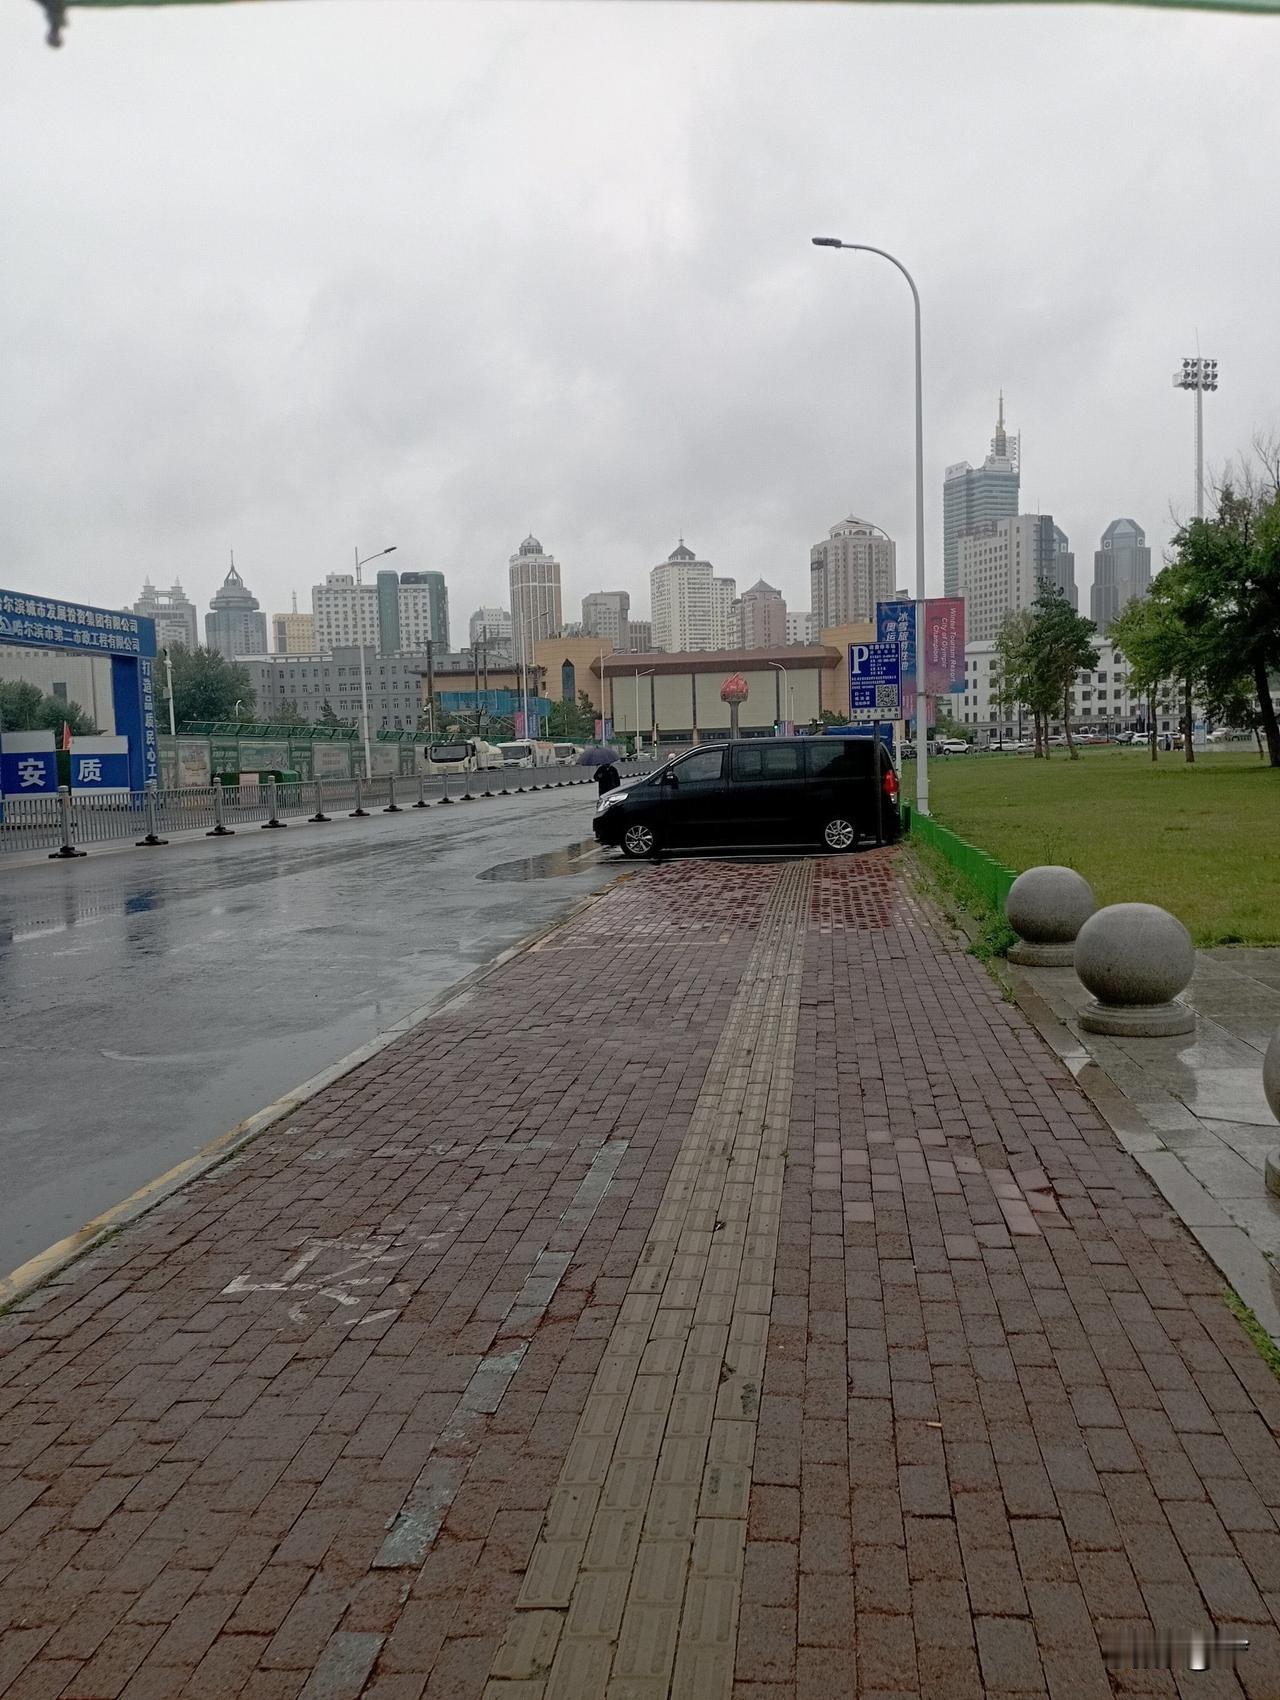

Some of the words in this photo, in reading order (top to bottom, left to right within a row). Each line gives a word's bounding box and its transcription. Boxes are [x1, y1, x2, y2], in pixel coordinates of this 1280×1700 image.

[0, 595, 138, 633] 尔滨城市发展投资集团有限公司
[12, 619, 140, 652] 哈尔滨市第二市政工程有限公司
[852, 645, 869, 674] P
[18, 758, 46, 787] 安
[78, 758, 102, 782] 质
